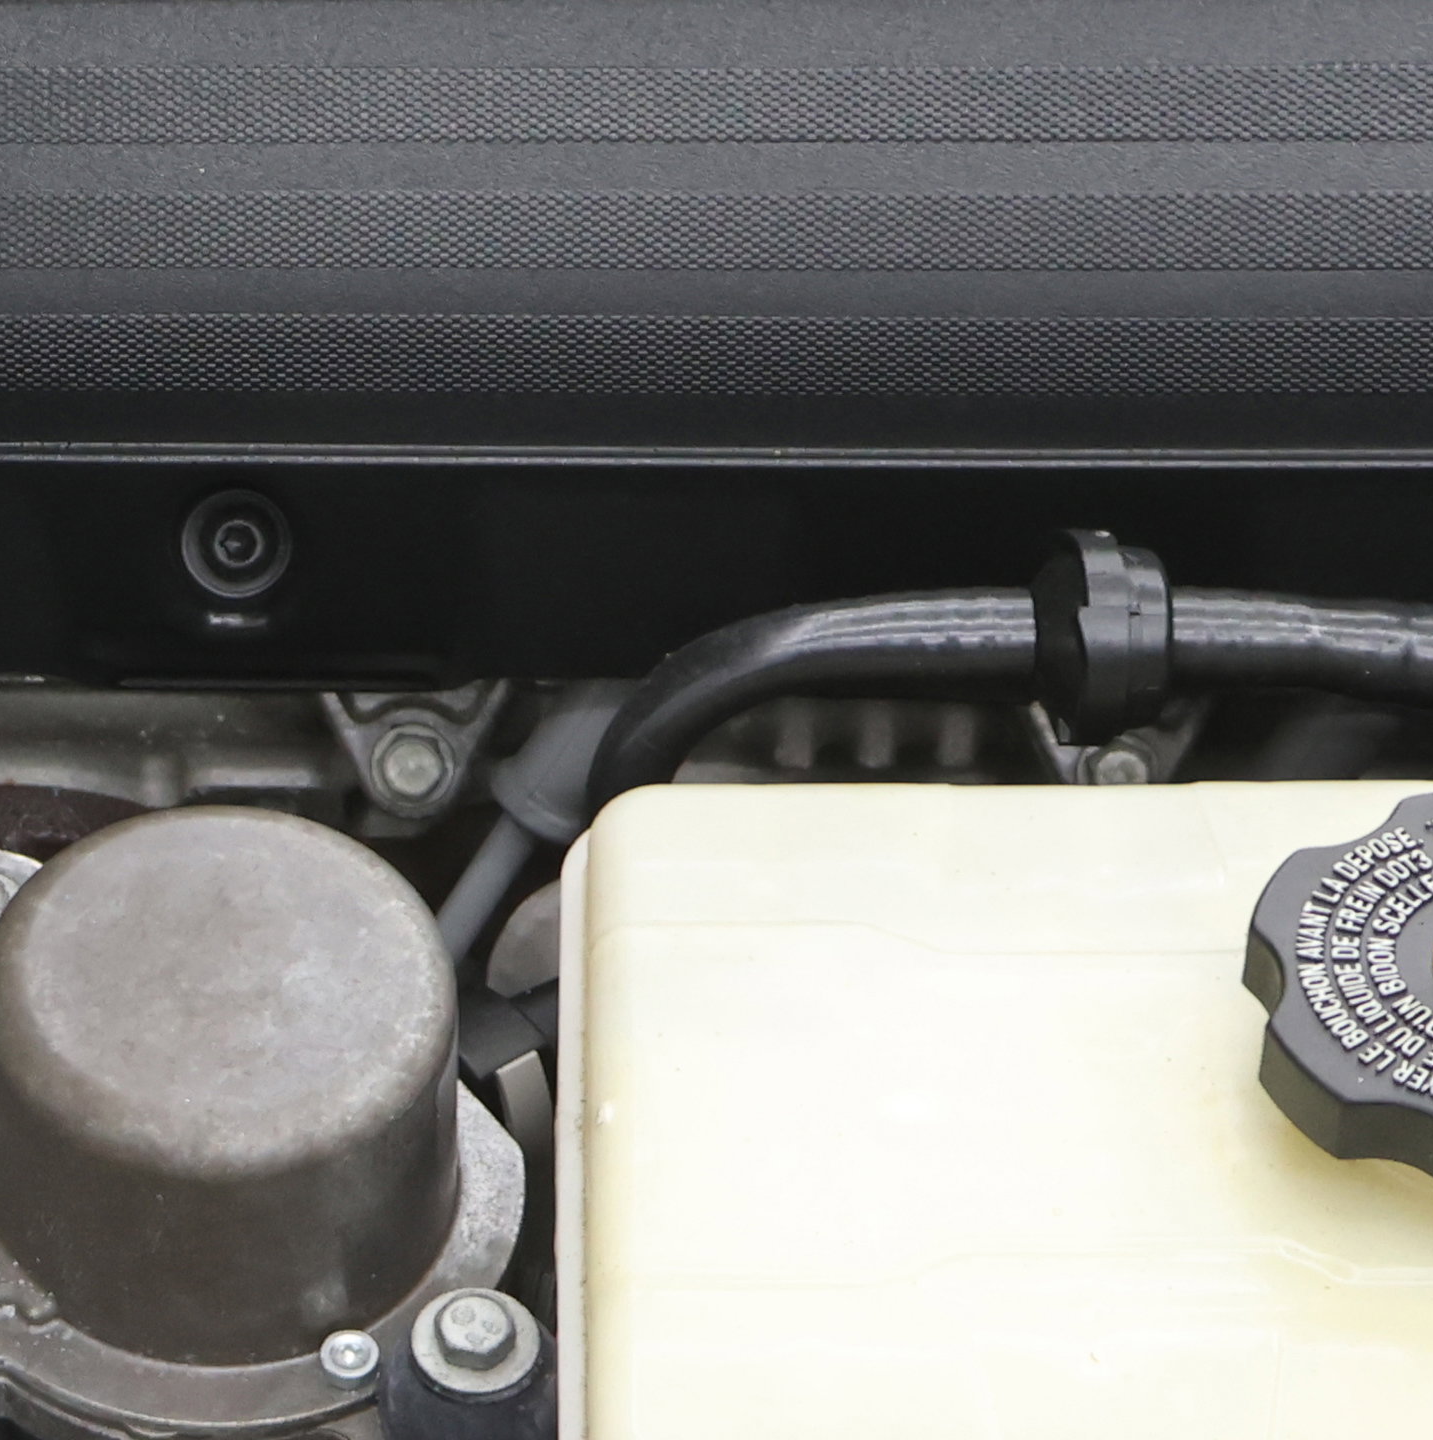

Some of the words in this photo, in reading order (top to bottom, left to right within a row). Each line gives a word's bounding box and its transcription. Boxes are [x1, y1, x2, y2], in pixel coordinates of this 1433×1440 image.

[1312, 877, 1349, 904] LA
[1373, 849, 1433, 888] DOT3
[1335, 880, 1386, 932] FREIN
[1296, 901, 1331, 960] AVANT
[1331, 935, 1360, 960] DE
[1367, 937, 1406, 996] BIDON
[1297, 963, 1369, 1050] BOUCHON
[1334, 963, 1396, 1034] LIQUIDE
[1358, 1042, 1396, 1072] LE
[1386, 1027, 1426, 1057] DU
